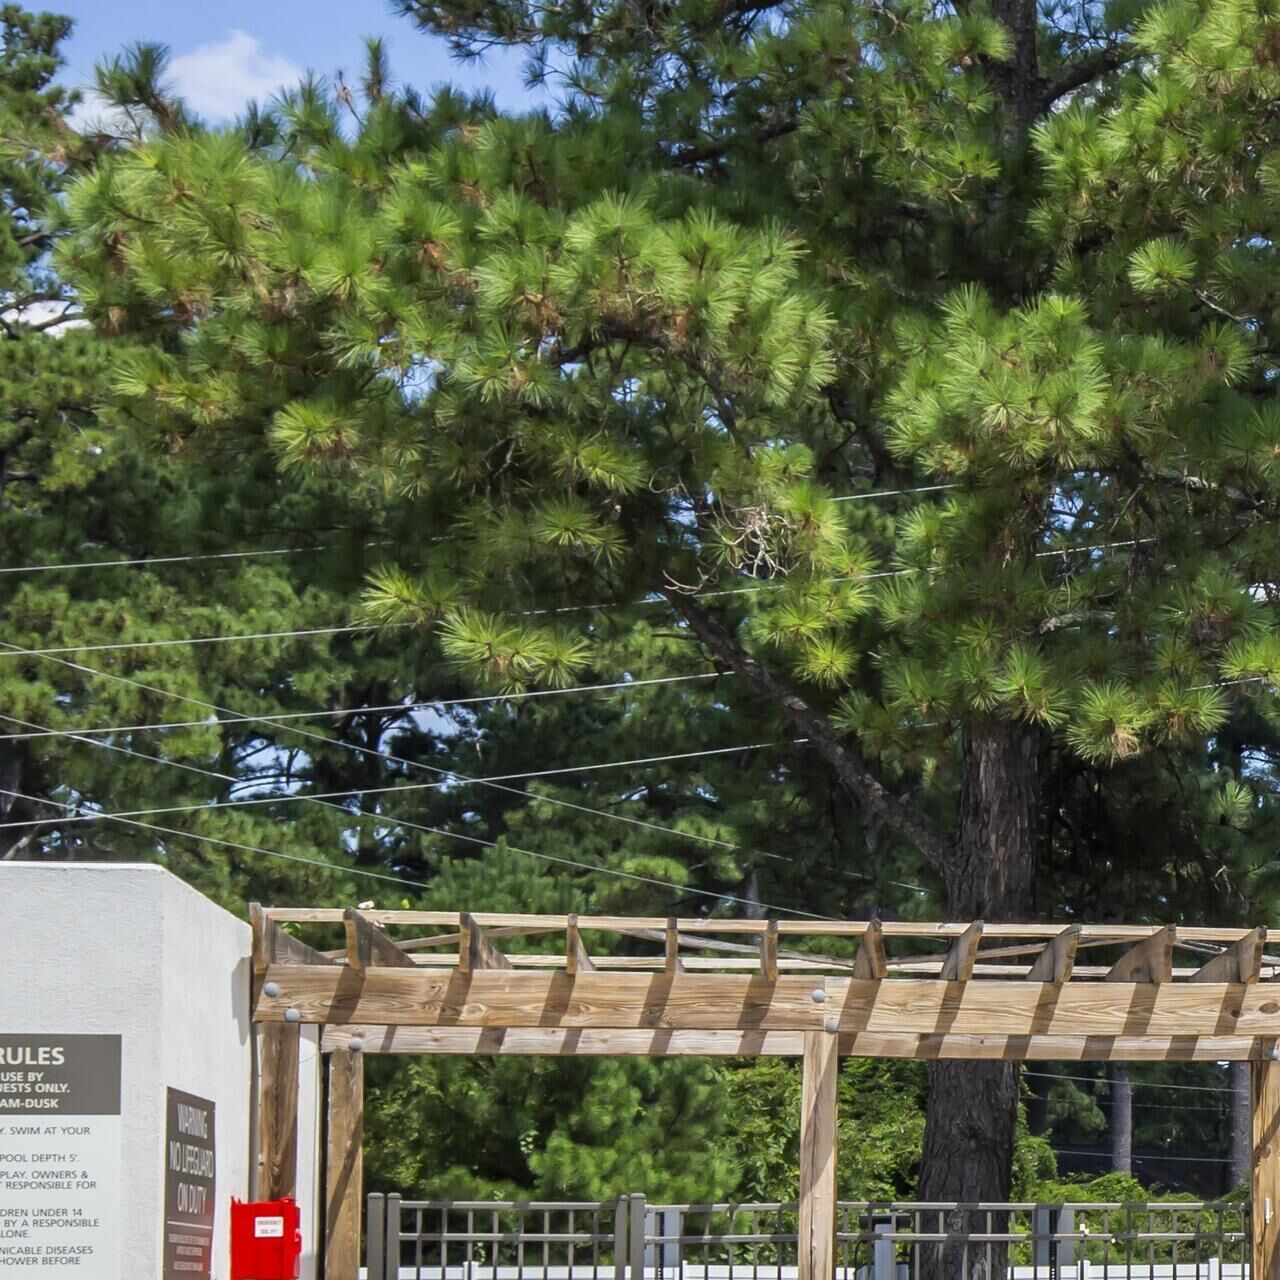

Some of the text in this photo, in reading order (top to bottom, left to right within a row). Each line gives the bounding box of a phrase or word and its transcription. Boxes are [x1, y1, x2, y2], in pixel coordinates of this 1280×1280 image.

[1, 1072, 44, 1081] USE BY
[35, 1083, 71, 1093] ONLY.
[10, 1126, 41, 1135] SWIM
[43, 1126, 57, 1135] AT
[60, 1126, 90, 1135] YOUR
[0, 1153, 28, 1162] POOL
[31, 1153, 66, 1162] DEPTH
[169, 1141, 181, 1172] NO
[31, 1170, 78, 1179] OWNERS
[80, 1170, 89, 1179] &
[5, 1180, 97, 1190] RESPONSIBLE FOR
[177, 1182, 207, 1215] ON DUTY
[32, 1208, 68, 1217] UNDER
[72, 1208, 82, 1217] 14
[4, 1218, 100, 1228] BY A RESPONSIBLE
[46, 1245, 94, 1255] DISEASES
[42, 1256, 81, 1266] BEFORE
